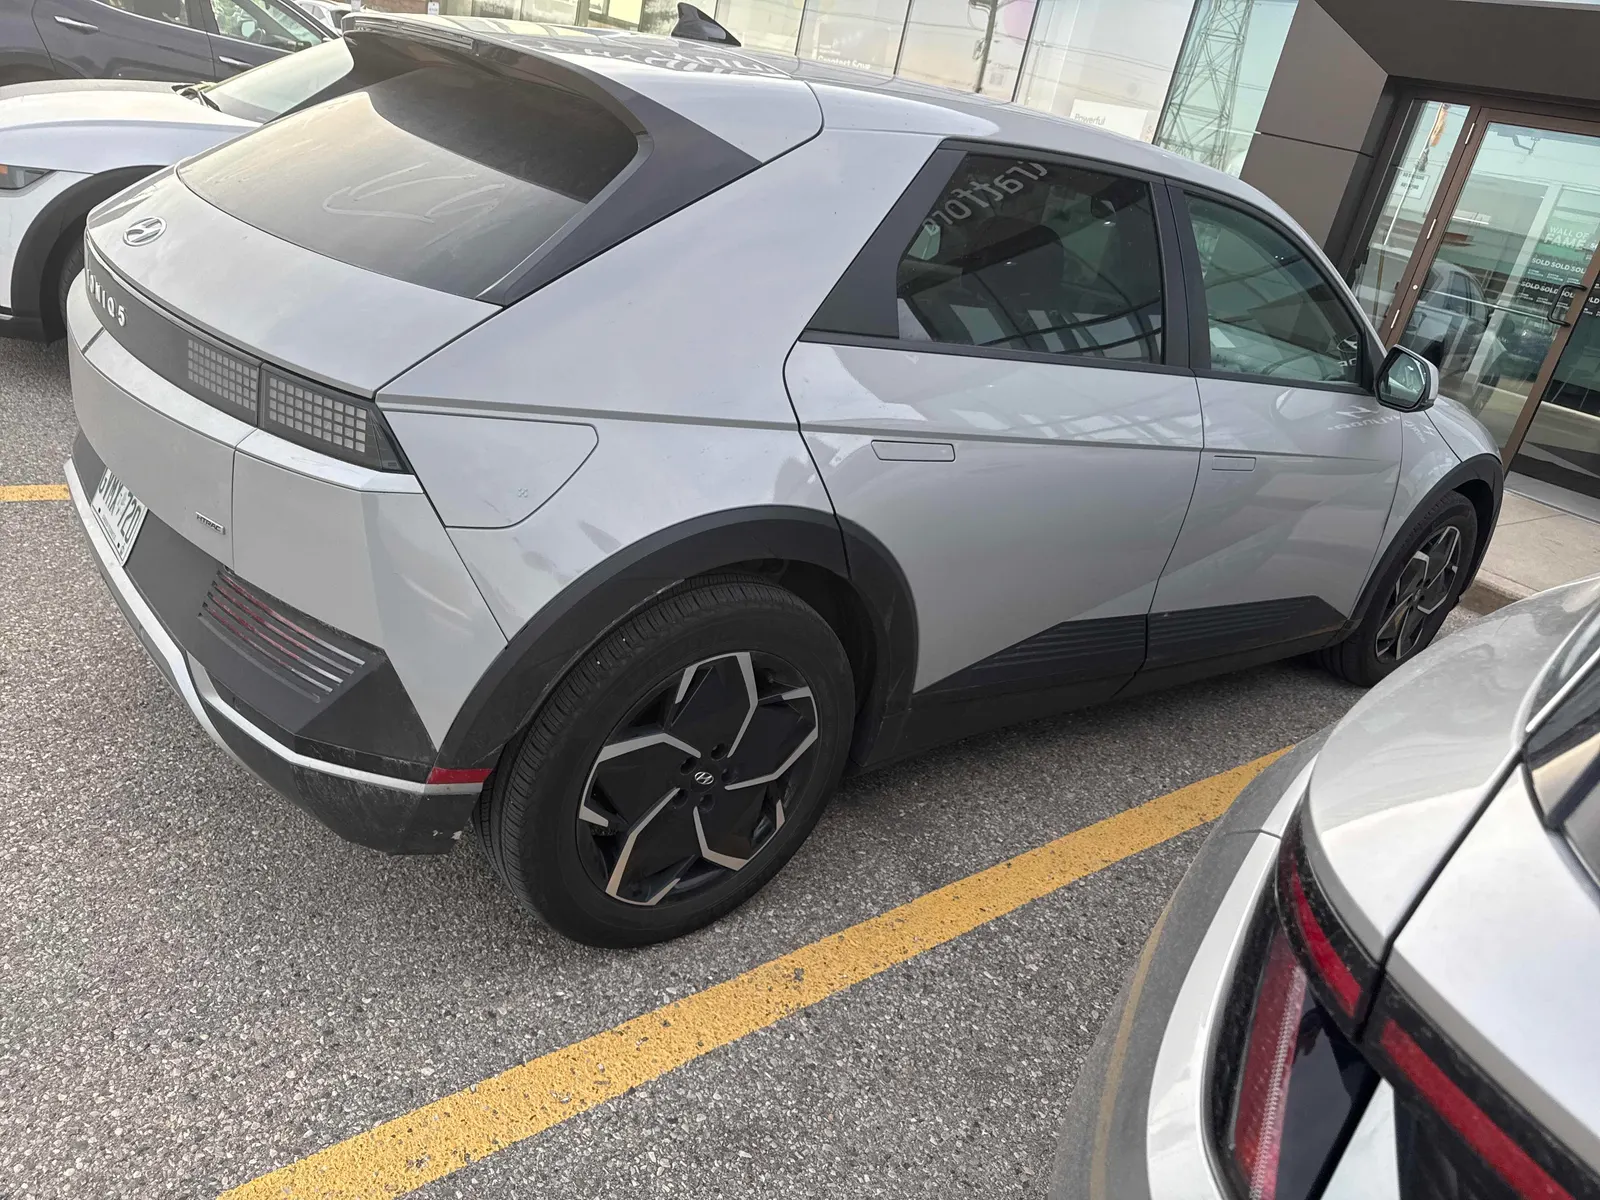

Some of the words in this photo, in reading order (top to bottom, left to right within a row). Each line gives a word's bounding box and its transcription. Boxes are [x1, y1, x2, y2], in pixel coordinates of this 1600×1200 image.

[1074, 113, 1106, 126] Powerful
[1543, 232, 1587, 250] FAME
[1549, 225, 1573, 237] WALL
[1575, 231, 1589, 240] OF
[1531, 257, 1550, 266] SOLD
[1550, 261, 1570, 271] SOLD
[1570, 265, 1586, 274] SOL
[1520, 281, 1540, 290] SOLD
[117, 305, 126, 327] 5
[117, 491, 142, 544] 720
[196, 514, 221, 533] HTRAC
